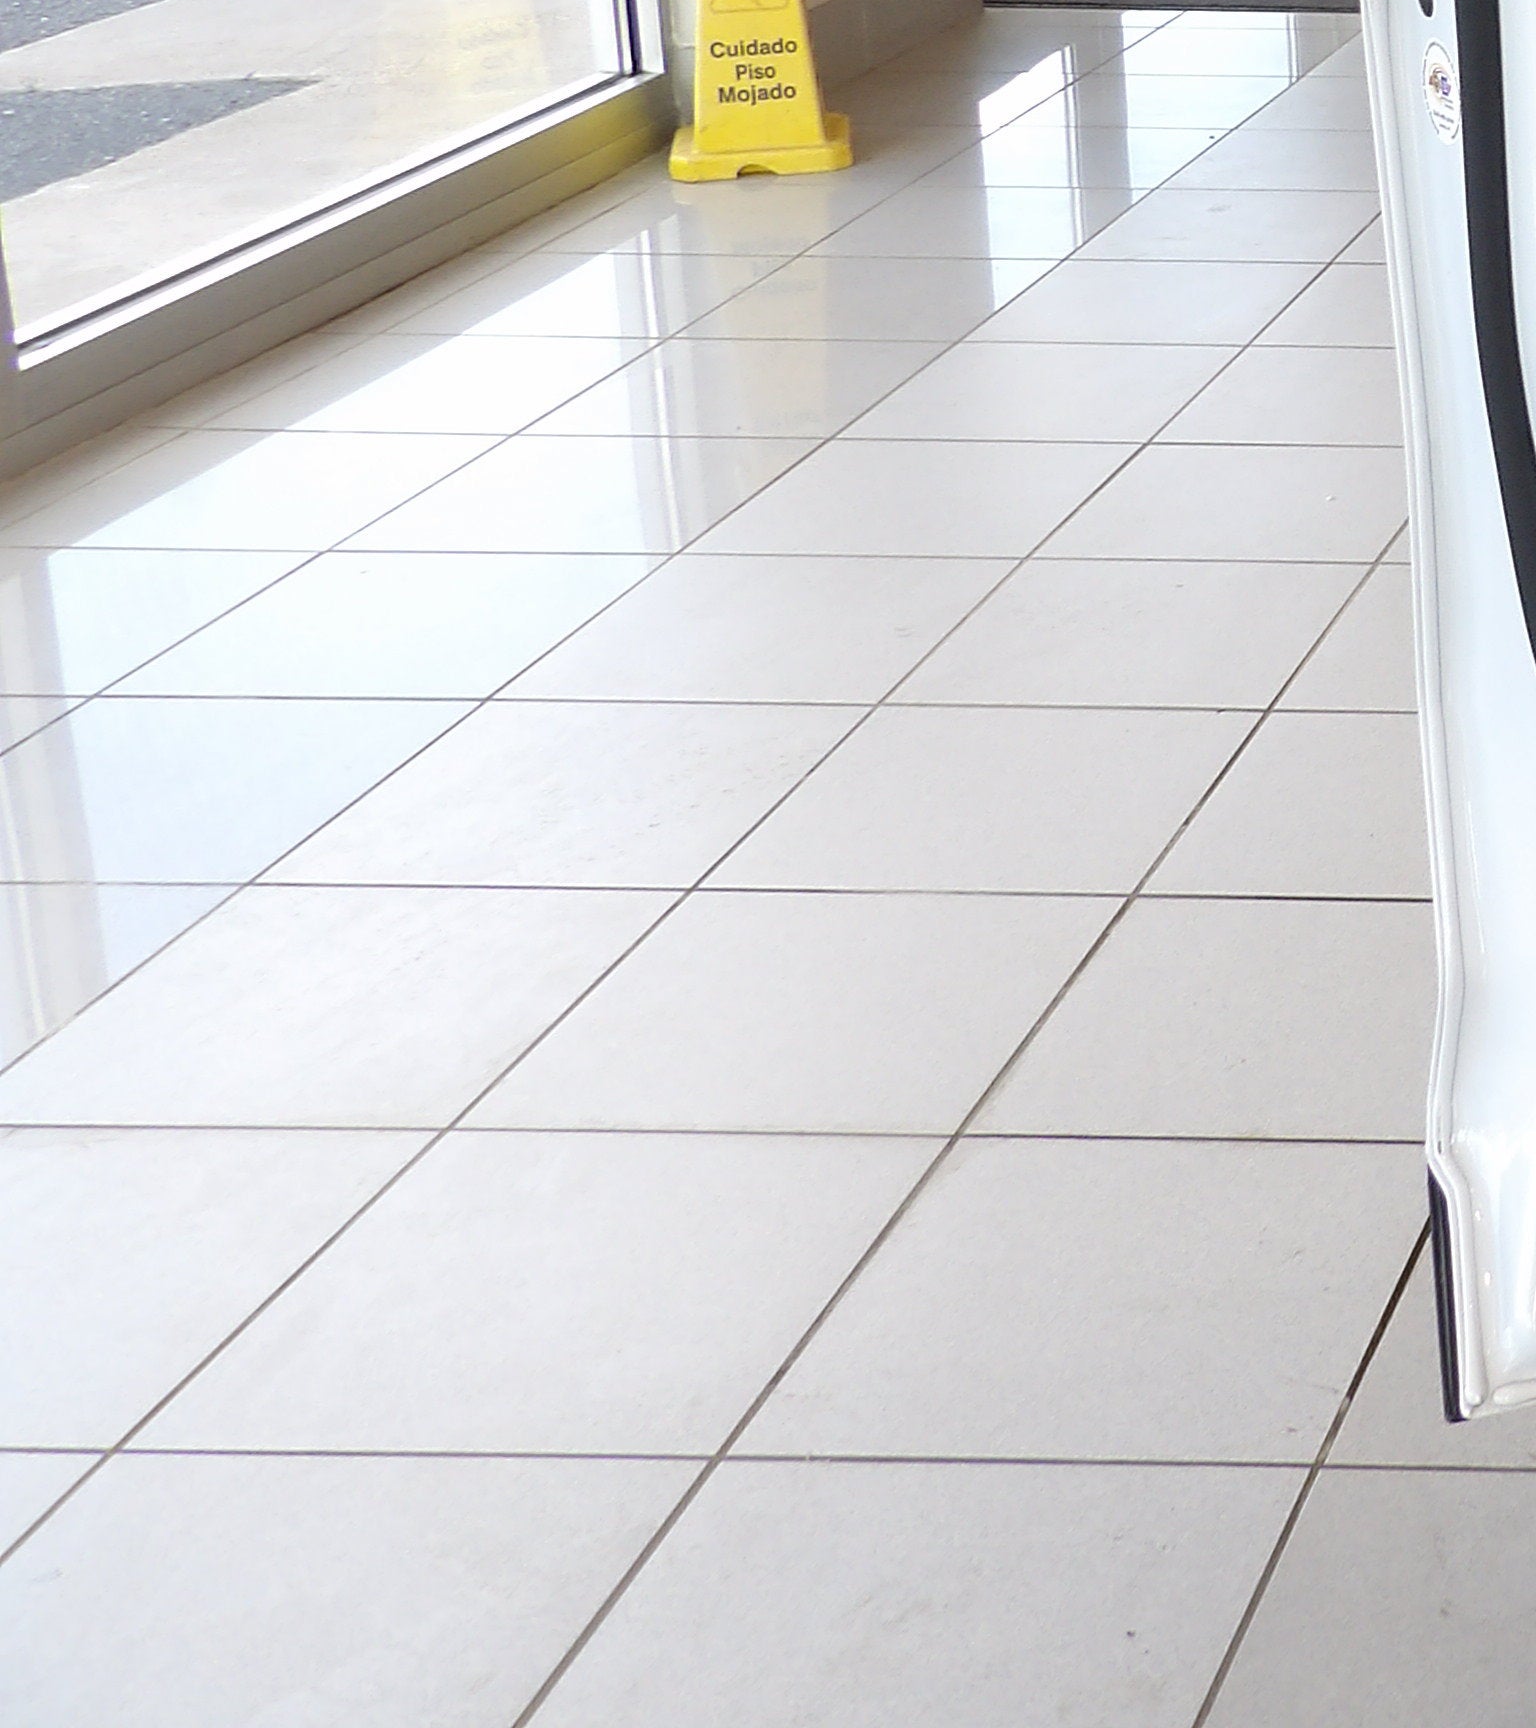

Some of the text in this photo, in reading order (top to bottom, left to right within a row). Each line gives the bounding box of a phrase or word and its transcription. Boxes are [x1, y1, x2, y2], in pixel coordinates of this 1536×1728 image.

[710, 37, 798, 59] Cuidado
[736, 63, 776, 81] Piso
[718, 83, 797, 106] Mojado
